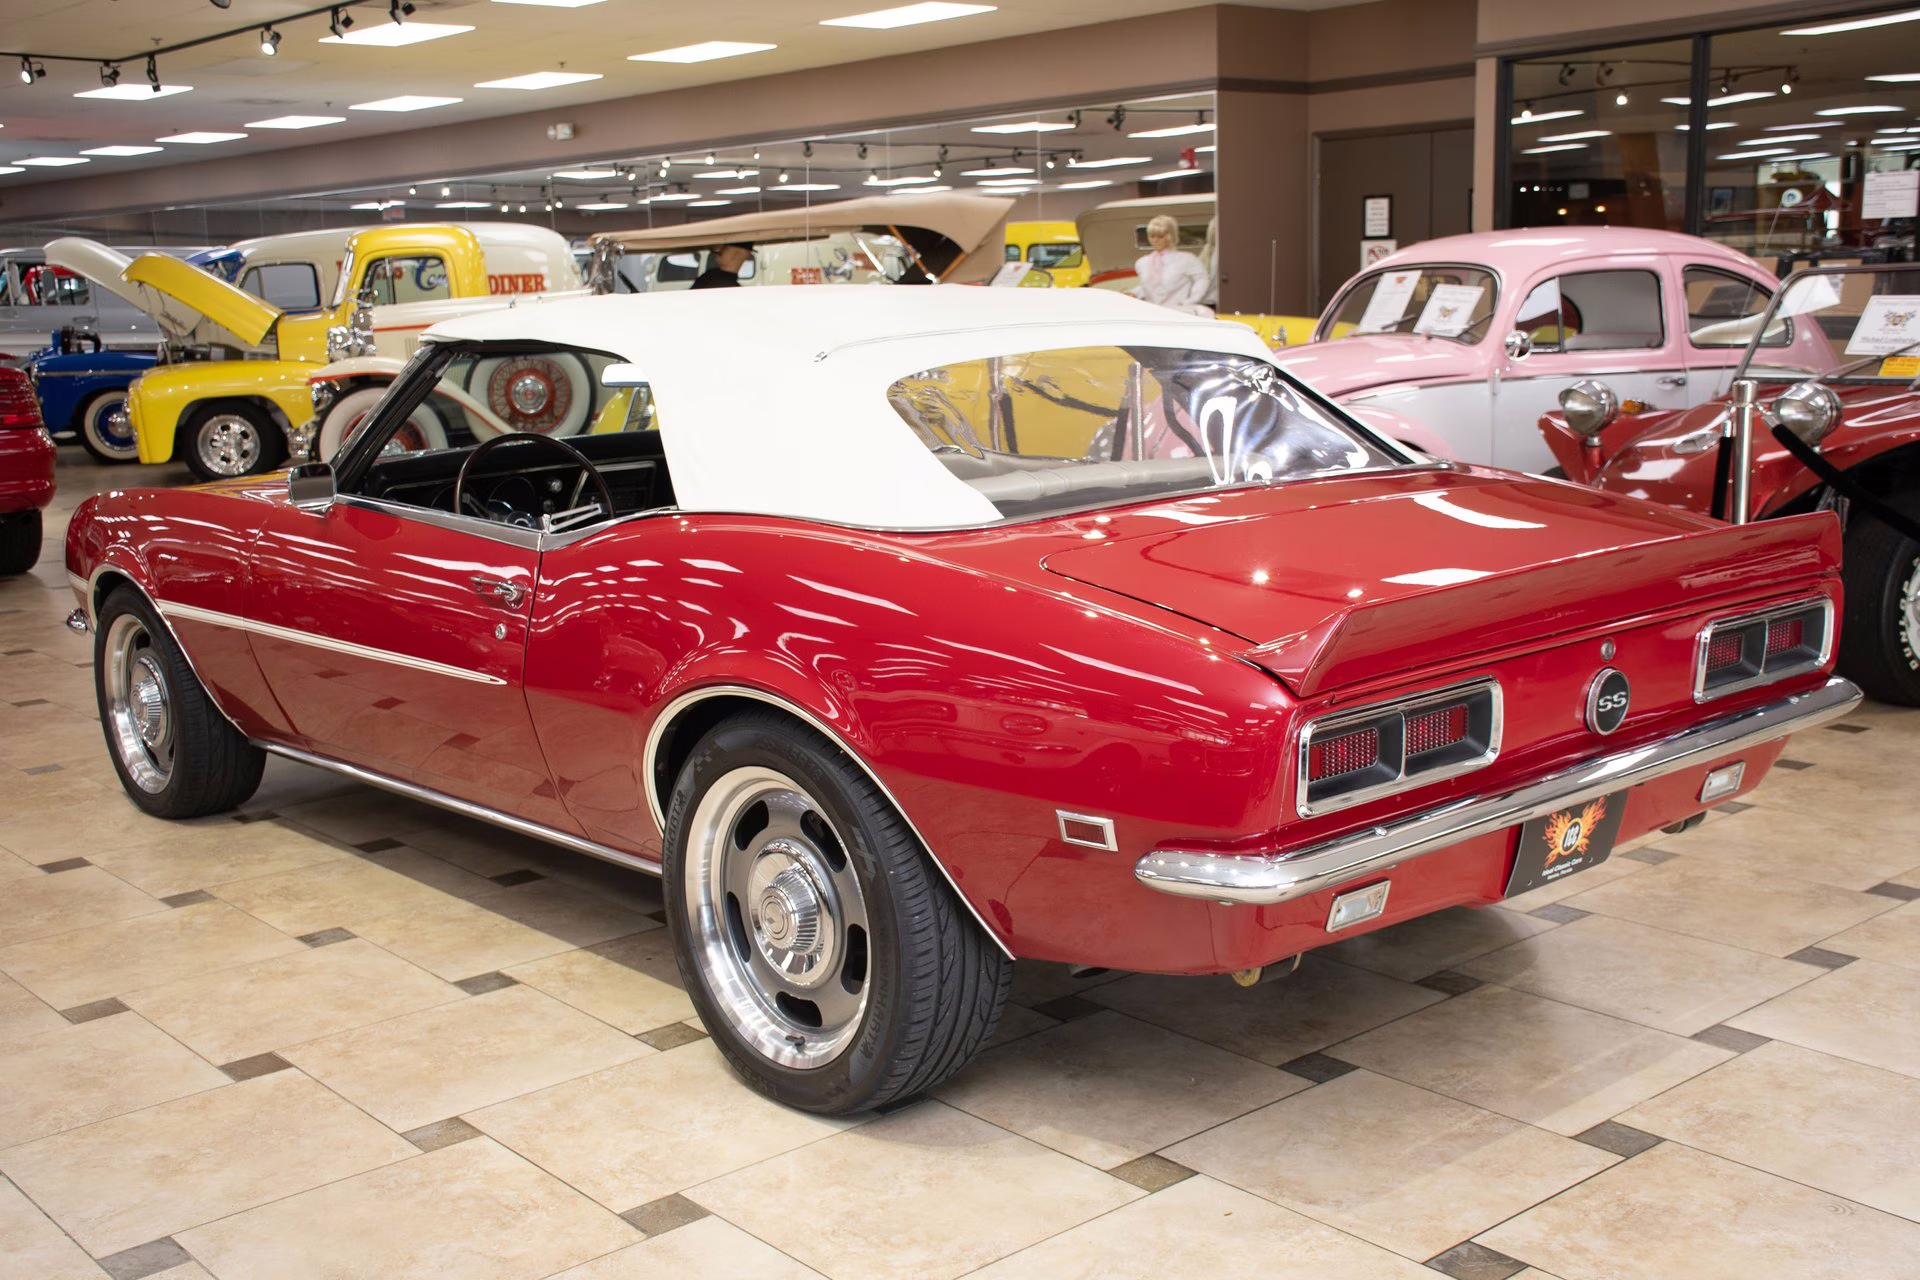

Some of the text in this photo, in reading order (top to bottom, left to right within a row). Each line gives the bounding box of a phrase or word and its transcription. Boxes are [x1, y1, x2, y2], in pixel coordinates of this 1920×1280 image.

[488, 273, 547, 295] DINER
[1598, 691, 1627, 712] SS
[664, 803, 684, 890] IONHART
